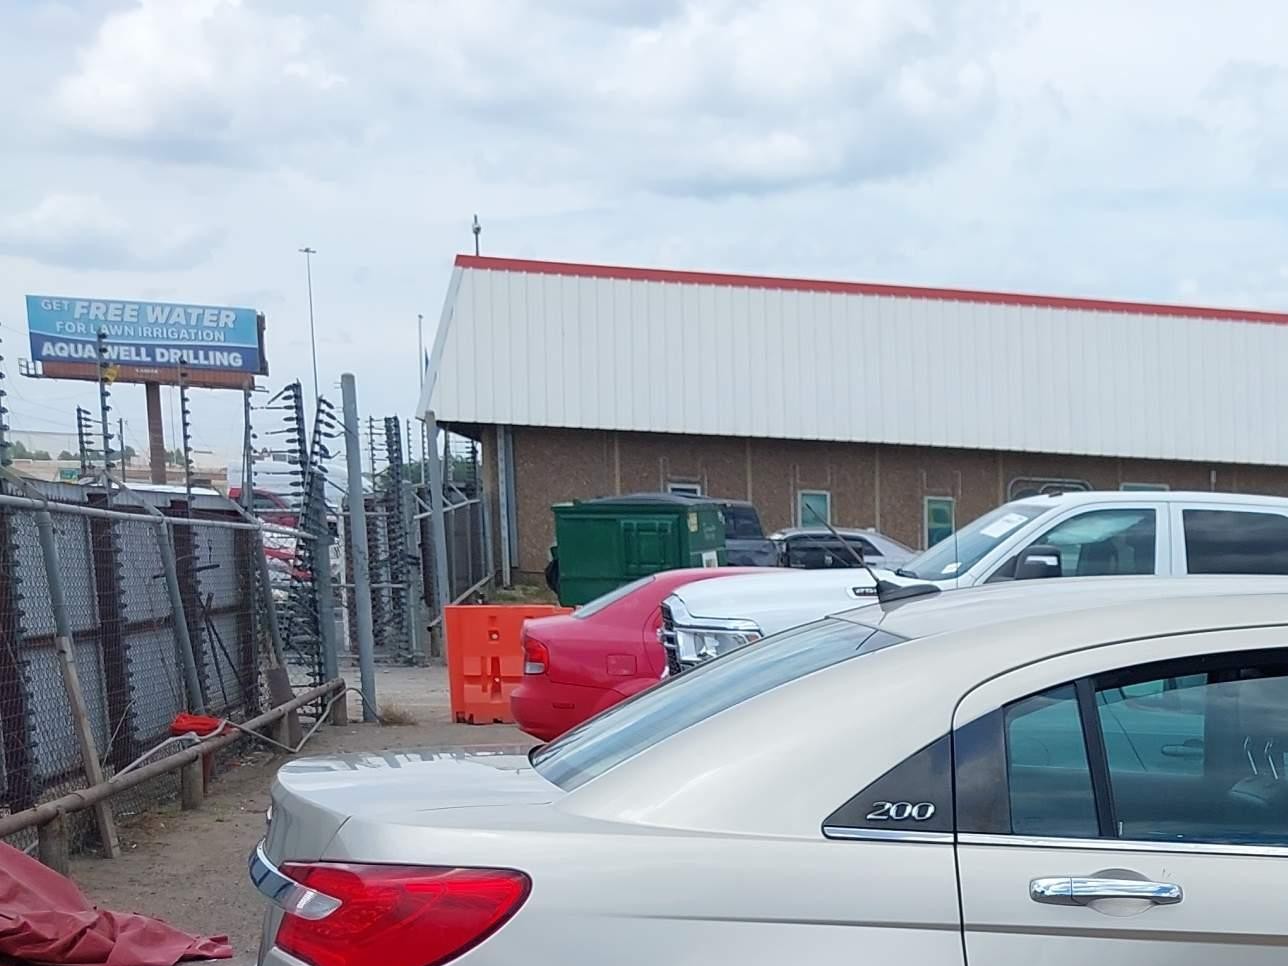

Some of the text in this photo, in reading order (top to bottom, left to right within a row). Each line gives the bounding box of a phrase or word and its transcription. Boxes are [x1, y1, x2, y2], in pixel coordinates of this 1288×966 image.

[41, 299, 236, 329] GET FREE WATER
[56, 321, 225, 341] FOR LAWN IRRIGATION
[42, 341, 243, 367] AQUA WELL DRILLING
[866, 801, 935, 820] 200
